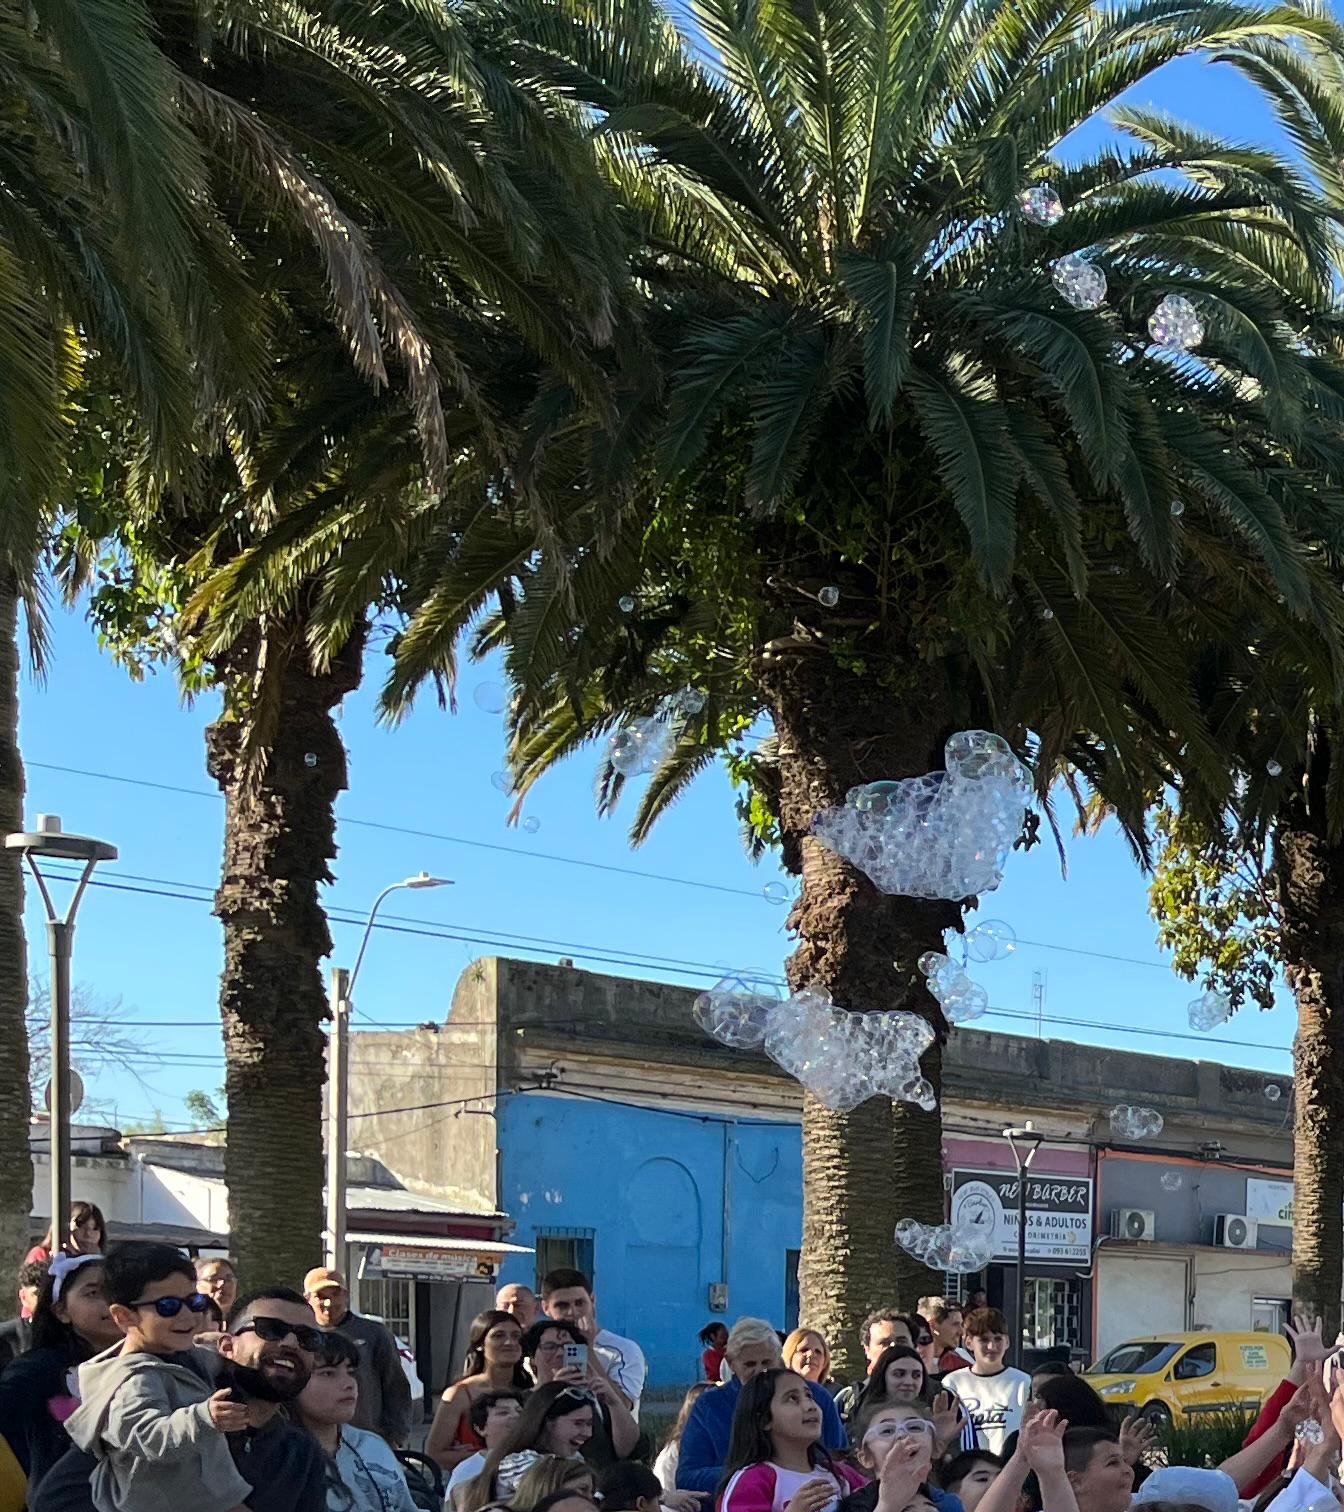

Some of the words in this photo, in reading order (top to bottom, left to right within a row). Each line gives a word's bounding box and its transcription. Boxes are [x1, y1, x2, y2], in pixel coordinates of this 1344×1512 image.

[1033, 1184, 1087, 1206] BARBER
[1035, 1215, 1043, 1227] &
[1045, 1216, 1087, 1229] ADULTOS
